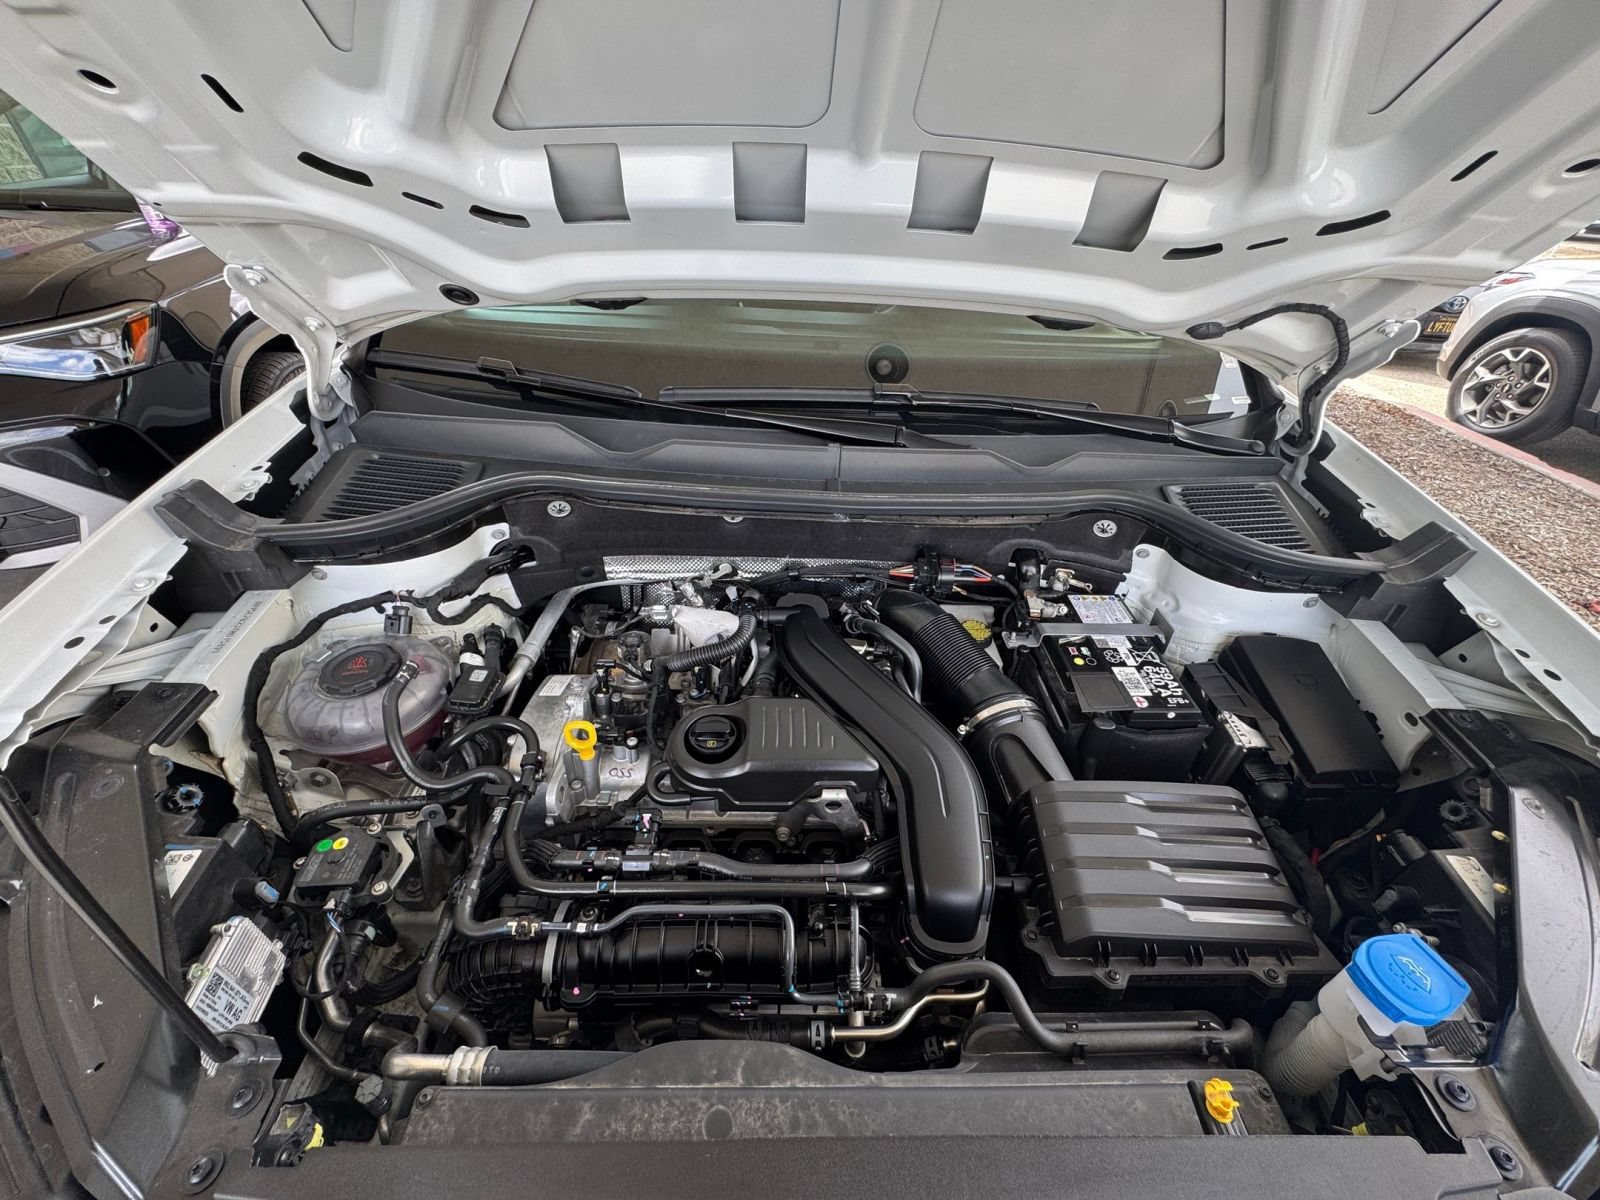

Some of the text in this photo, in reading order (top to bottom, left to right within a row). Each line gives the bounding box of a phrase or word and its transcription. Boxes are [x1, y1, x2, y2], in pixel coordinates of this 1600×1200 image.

[1427, 321, 1456, 333] LYFTU
[1143, 666, 1165, 685] 640
[1157, 688, 1173, 697] A
[1155, 667, 1183, 695] 59Ah
[223, 998, 235, 1015] VW
[231, 1007, 243, 1021] AG
